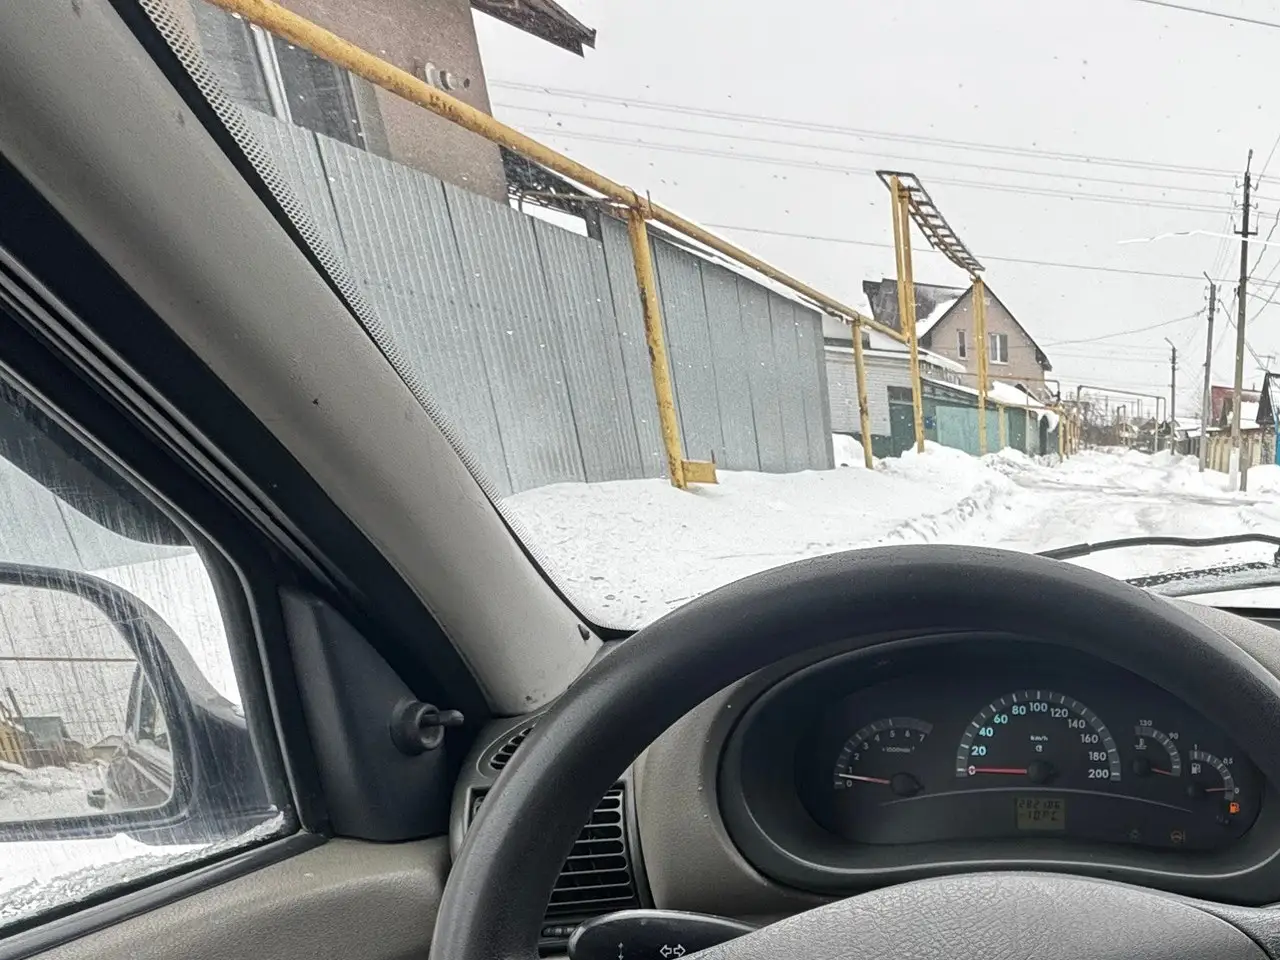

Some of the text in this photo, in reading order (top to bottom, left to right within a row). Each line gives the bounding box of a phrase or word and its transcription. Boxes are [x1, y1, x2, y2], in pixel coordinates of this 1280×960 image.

[1011, 705, 1027, 715] 80
[1029, 702, 1048, 712] 100
[1051, 708, 1069, 718] 120
[993, 714, 1009, 724] 60
[1068, 719, 1086, 729] 140
[919, 733, 926, 742] 7
[978, 727, 994, 738] 40
[874, 734, 880, 742] 4
[1080, 734, 1099, 743] 160
[862, 742, 869, 750] 3
[971, 745, 987, 756] 20
[853, 752, 860, 761] 2
[1088, 751, 1107, 761] 180
[968, 765, 976, 775] 0
[1088, 769, 1109, 779] 200
[846, 779, 853, 788] 0
[1234, 787, 1240, 795] 0
